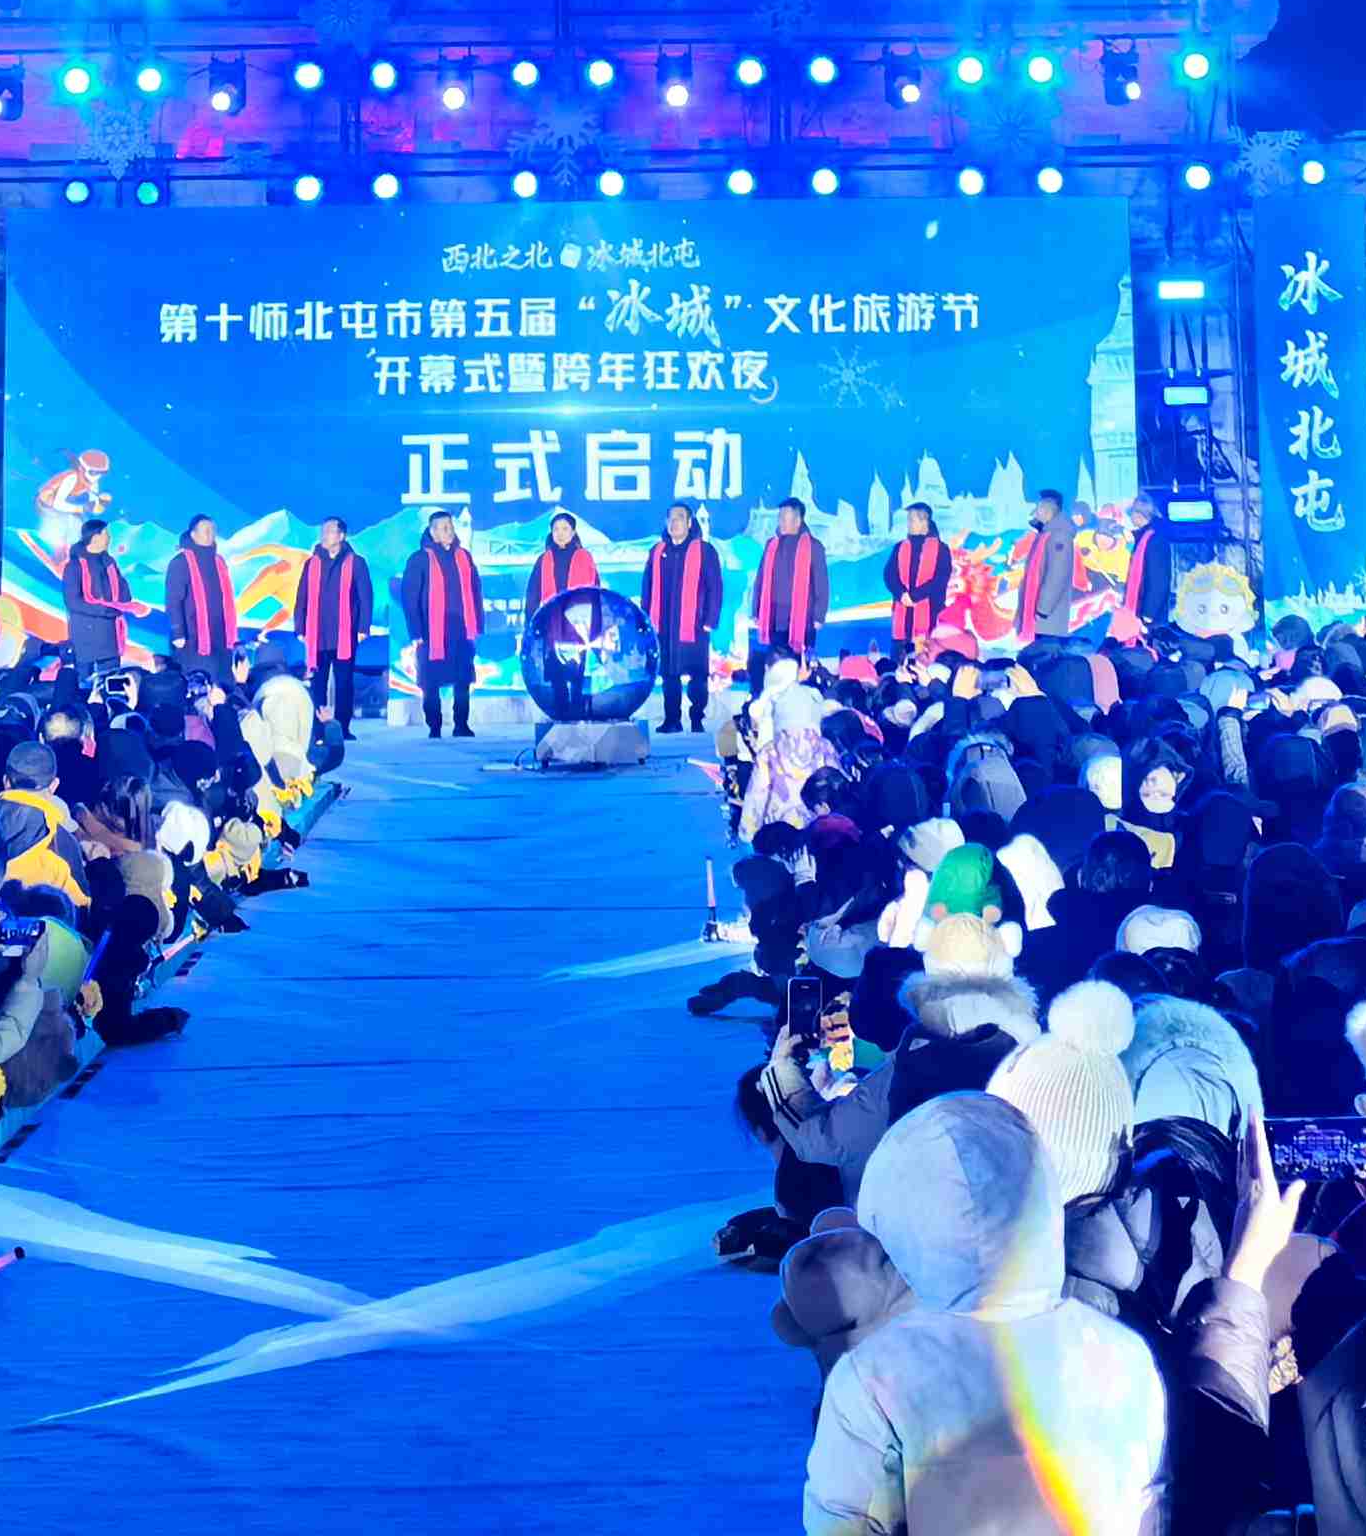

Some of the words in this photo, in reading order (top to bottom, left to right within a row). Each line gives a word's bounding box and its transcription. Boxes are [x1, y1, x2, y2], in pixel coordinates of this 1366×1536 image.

[442, 240, 553, 273] 西北之北
[585, 237, 701, 273] 冰城北屯
[373, 350, 770, 396] 开幕式暨跨年狂欢夜
[1279, 251, 1346, 533] 冰城北屯
[401, 428, 743, 505] 正式启动
